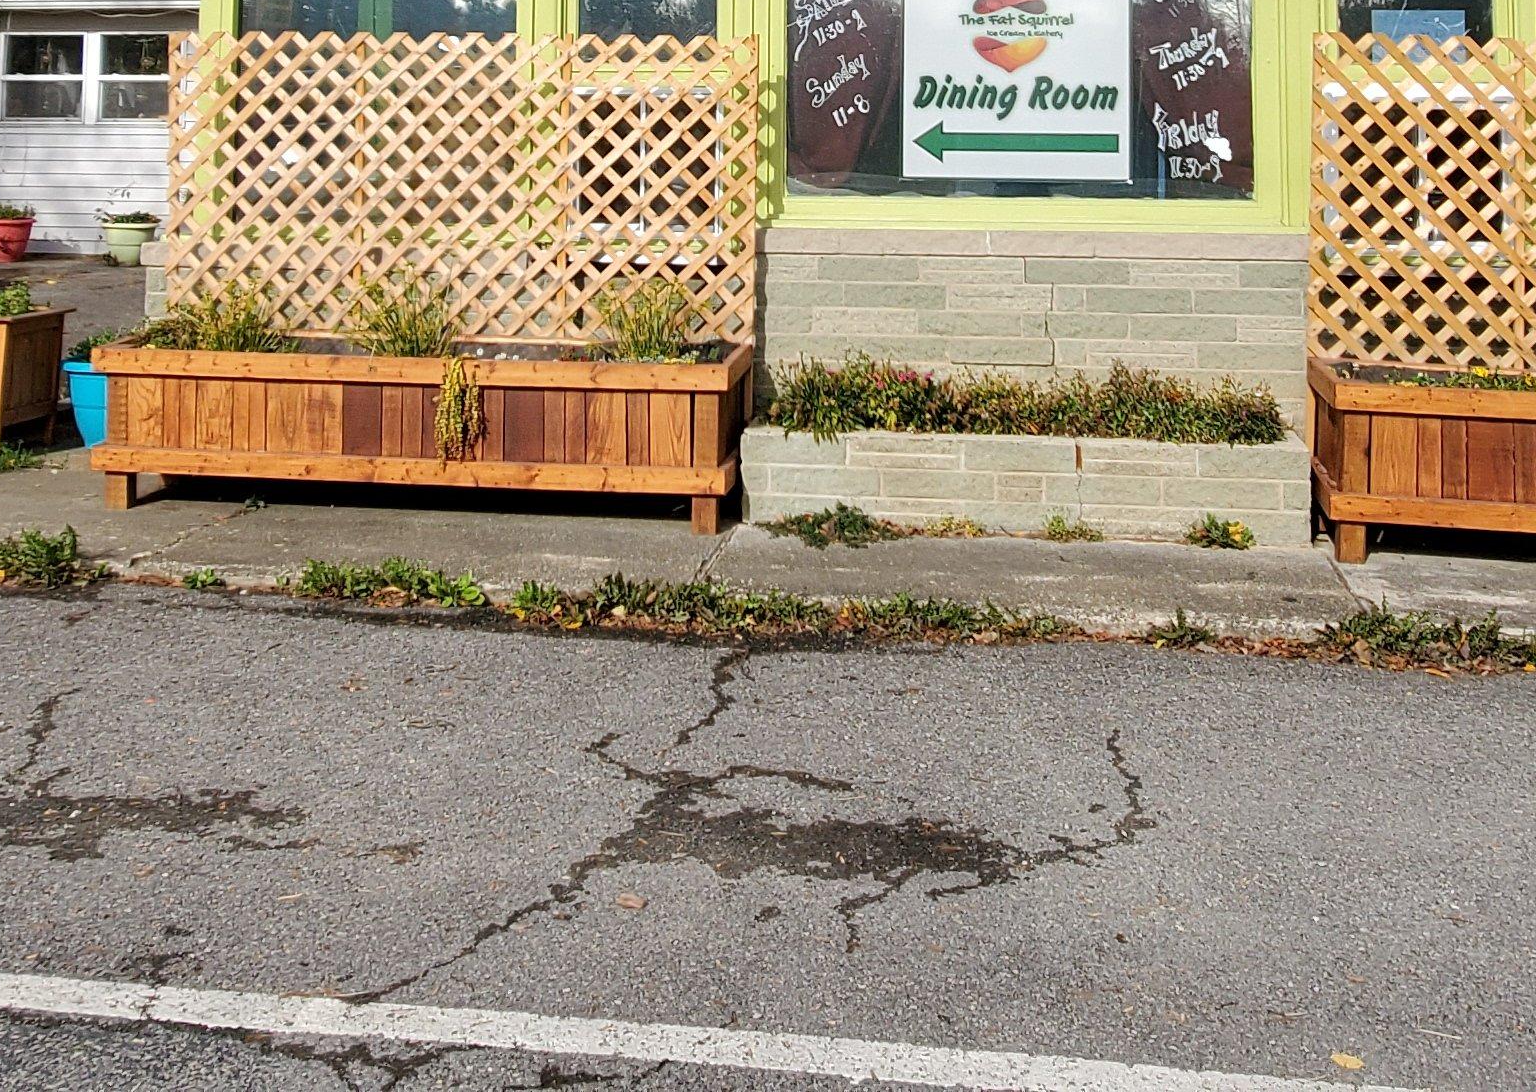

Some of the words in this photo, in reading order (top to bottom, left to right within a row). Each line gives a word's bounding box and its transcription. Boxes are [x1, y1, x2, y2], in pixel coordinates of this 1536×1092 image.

[959, 14, 984, 25] The
[988, 13, 1015, 26] Fat
[1018, 13, 1074, 29] Squirrel
[805, 54, 871, 109] Sunday
[913, 74, 1018, 121] Dining
[1028, 76, 1119, 111] Room
